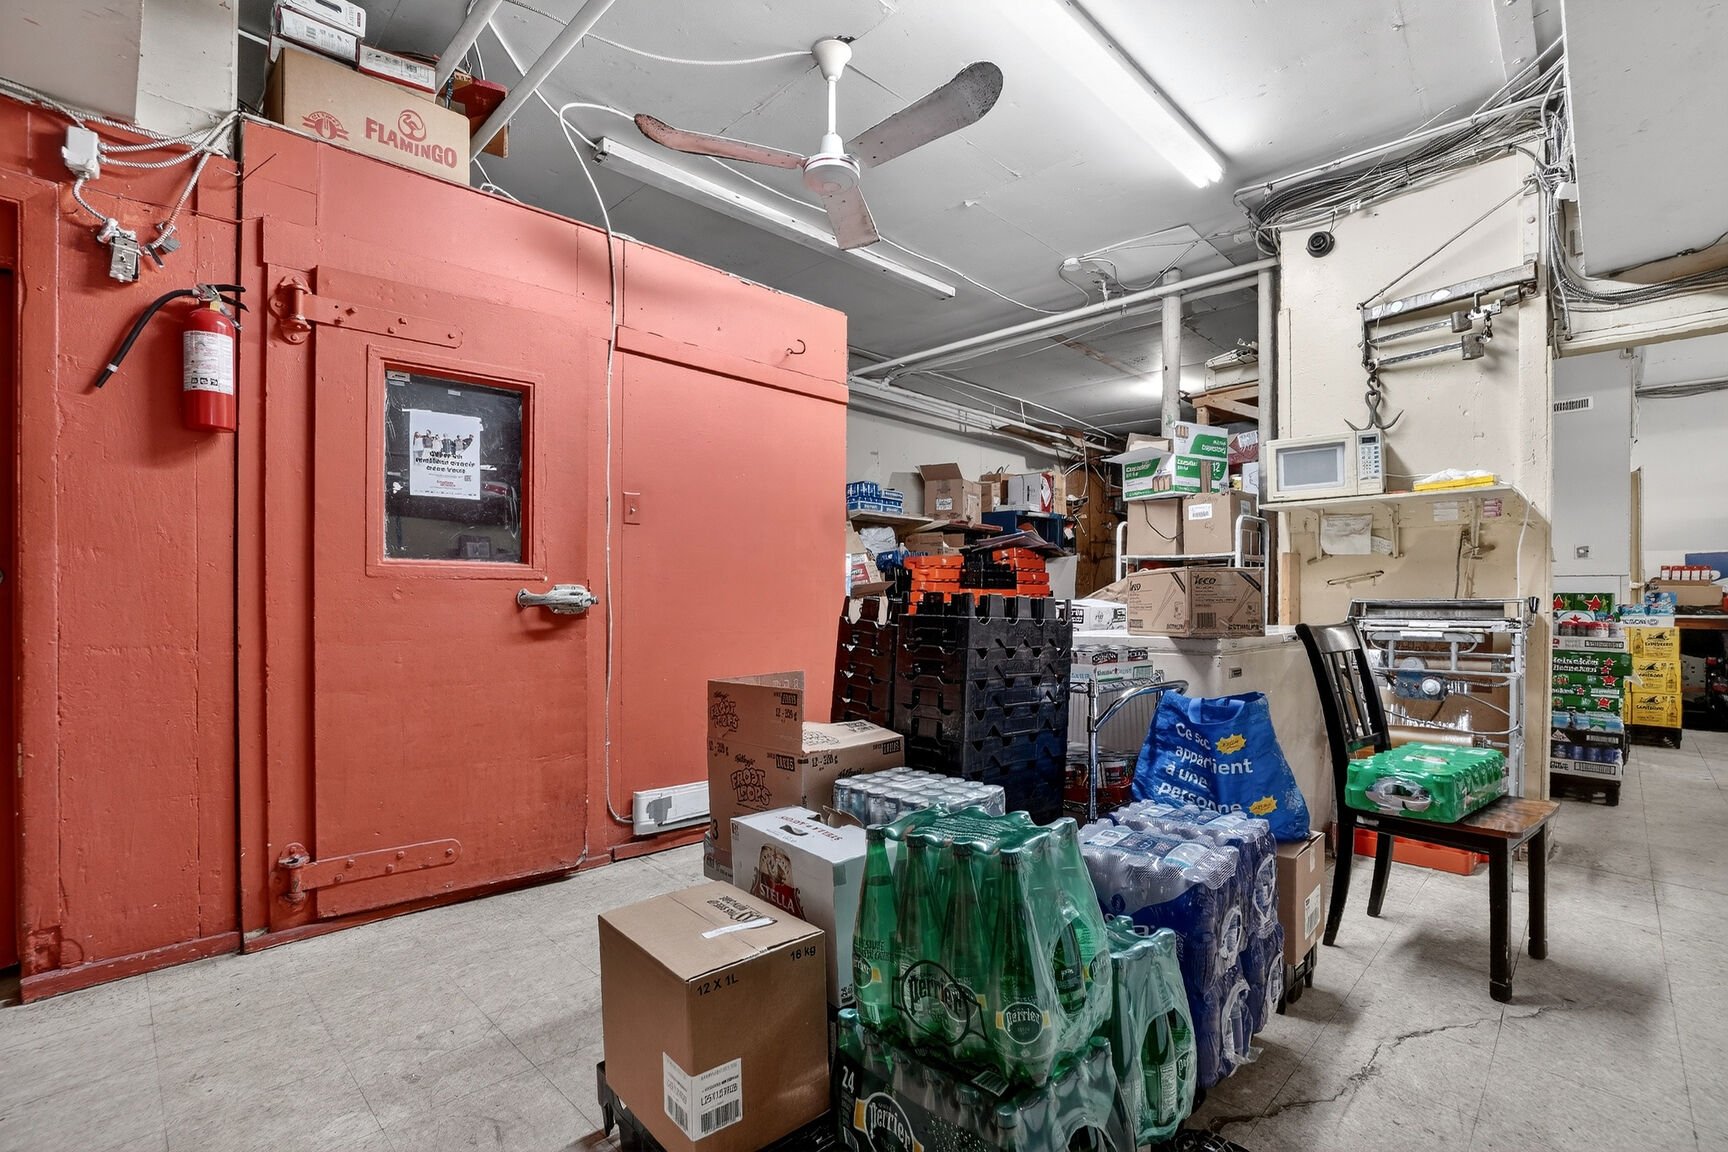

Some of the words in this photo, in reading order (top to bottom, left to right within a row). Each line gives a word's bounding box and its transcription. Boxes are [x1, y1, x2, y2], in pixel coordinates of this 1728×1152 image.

[365, 116, 458, 169] FLAMINGO
[1176, 722, 1193, 741] Ce
[730, 767, 766, 791] FROOT
[1178, 769, 1208, 788] une
[760, 882, 796, 913] STELLA
[804, 945, 816, 957] kg
[696, 982, 711, 996] 12
[713, 978, 723, 990] X
[725, 973, 739, 986] 1L
[842, 1065, 855, 1094] 24
